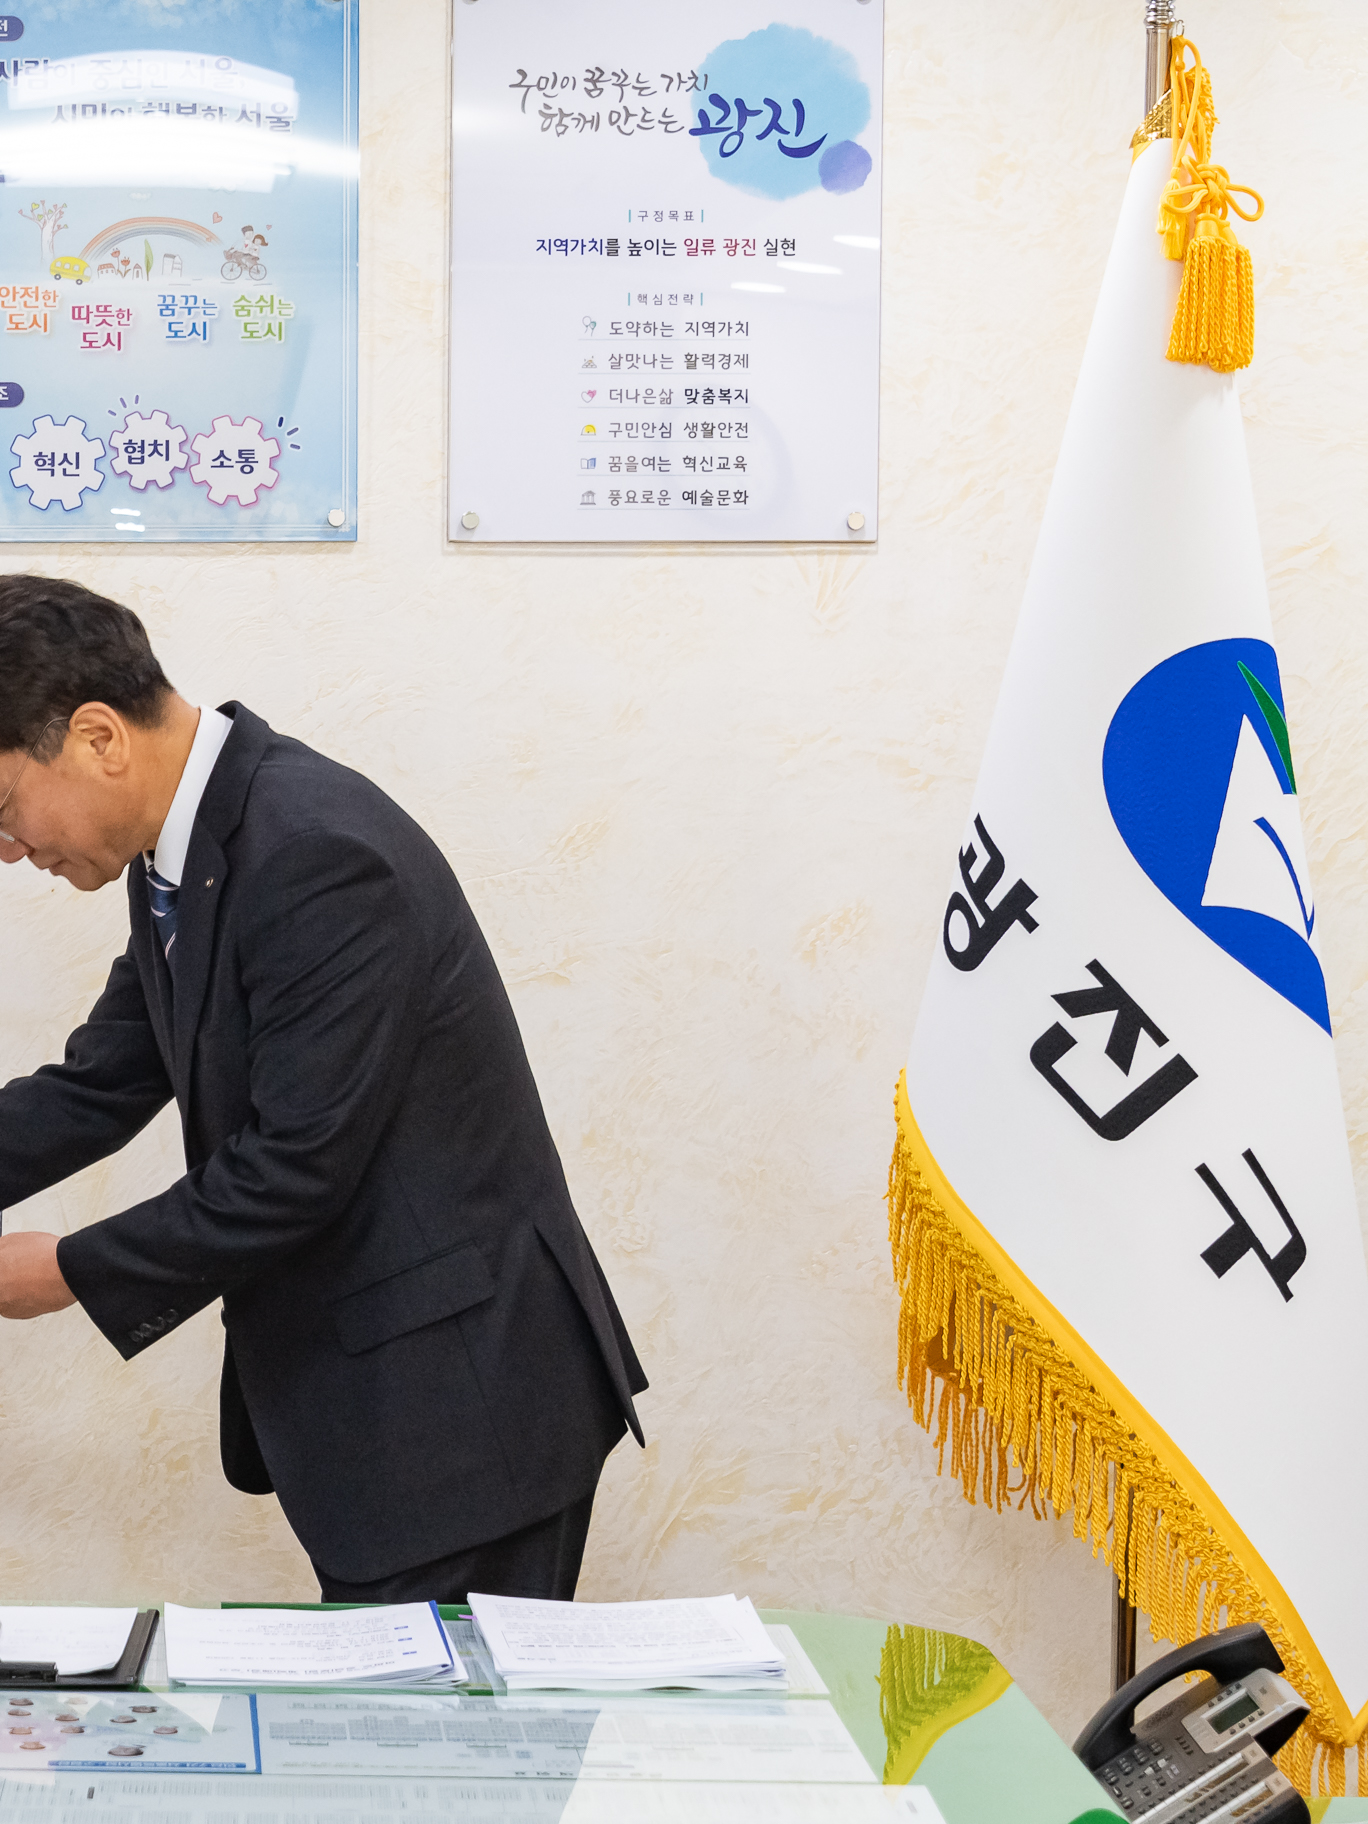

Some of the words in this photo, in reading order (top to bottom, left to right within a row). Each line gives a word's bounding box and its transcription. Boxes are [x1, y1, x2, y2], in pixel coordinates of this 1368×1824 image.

[508, 68, 577, 116] 구민이
[583, 66, 658, 104] 꿈꾸는
[660, 70, 710, 93] 가치
[234, 102, 294, 132] 서울
[538, 102, 601, 138] 함께
[608, 105, 685, 137] 만드는
[688, 93, 828, 158] 광진
[637, 210, 694, 223] 구정목표
[536, 237, 621, 257] 지역가치를
[626, 238, 677, 257] 높이는
[683, 238, 717, 257] 일류
[722, 238, 756, 257] 광진
[763, 237, 796, 257] 실현
[156, 294, 219, 319] 꿈꾸는
[231, 293, 294, 319] 숨쉬는
[637, 293, 694, 306] 핵심전략
[6, 313, 50, 334] 도시
[70, 304, 134, 329] 따뜻한
[164, 320, 209, 343] 도시
[240, 320, 284, 343] 도시
[609, 320, 675, 338] 도약하는
[684, 320, 749, 338] 지역가치
[79, 330, 123, 352] 도시
[608, 353, 674, 370] 살맛나는
[683, 352, 749, 370] 활력경제
[609, 388, 674, 405] 더나은삶
[684, 387, 749, 405] 맞춤복지
[608, 422, 672, 439] 구민안심
[683, 421, 749, 439] 생활안전
[32, 451, 80, 478] 혁신
[122, 438, 170, 465] 협치
[210, 448, 259, 475] 소통
[608, 455, 672, 473] 꿈을여는
[682, 455, 748, 473] 혁신교육
[607, 489, 672, 507] 풍요로운
[681, 489, 749, 507] 예술문화
[943, 812, 1307, 1303] 광진구
